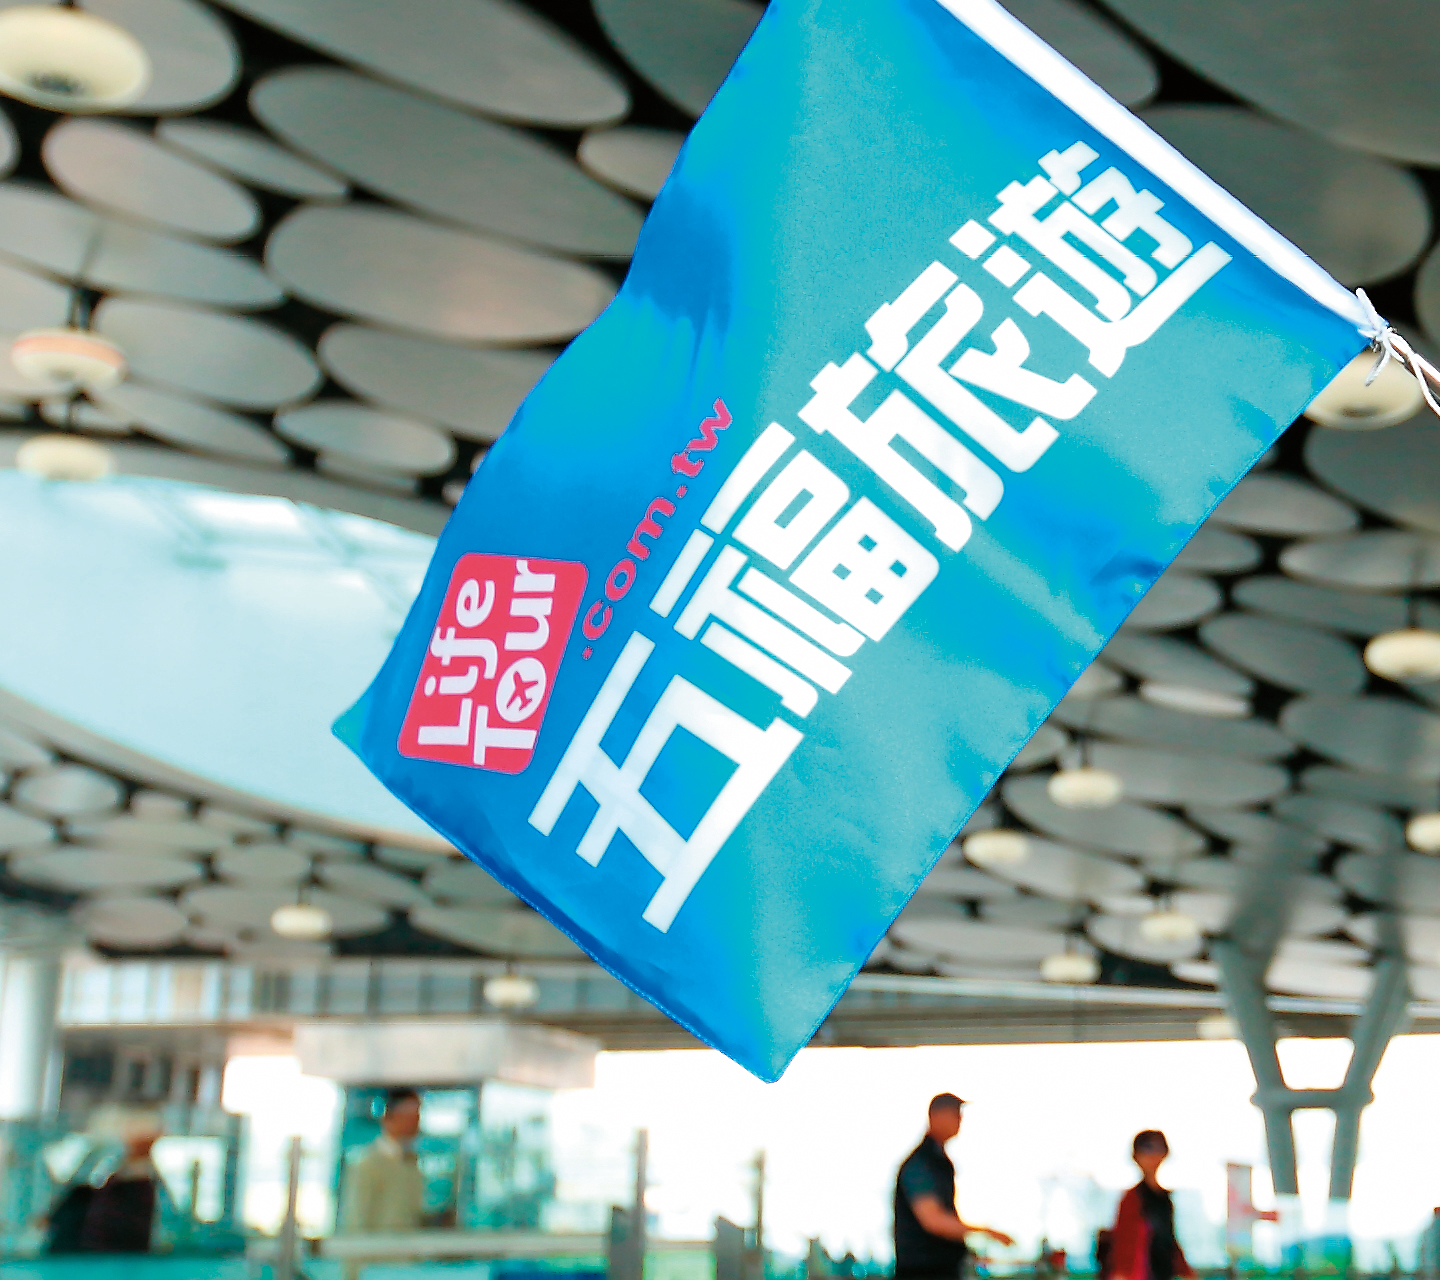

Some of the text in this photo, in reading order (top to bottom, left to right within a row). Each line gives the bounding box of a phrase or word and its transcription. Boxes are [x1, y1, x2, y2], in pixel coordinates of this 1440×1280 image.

[527, 139, 1233, 934] 五福旅遊
[582, 397, 733, 660] .com.tw
[417, 578, 498, 746] Life
[473, 559, 558, 766] Tour
